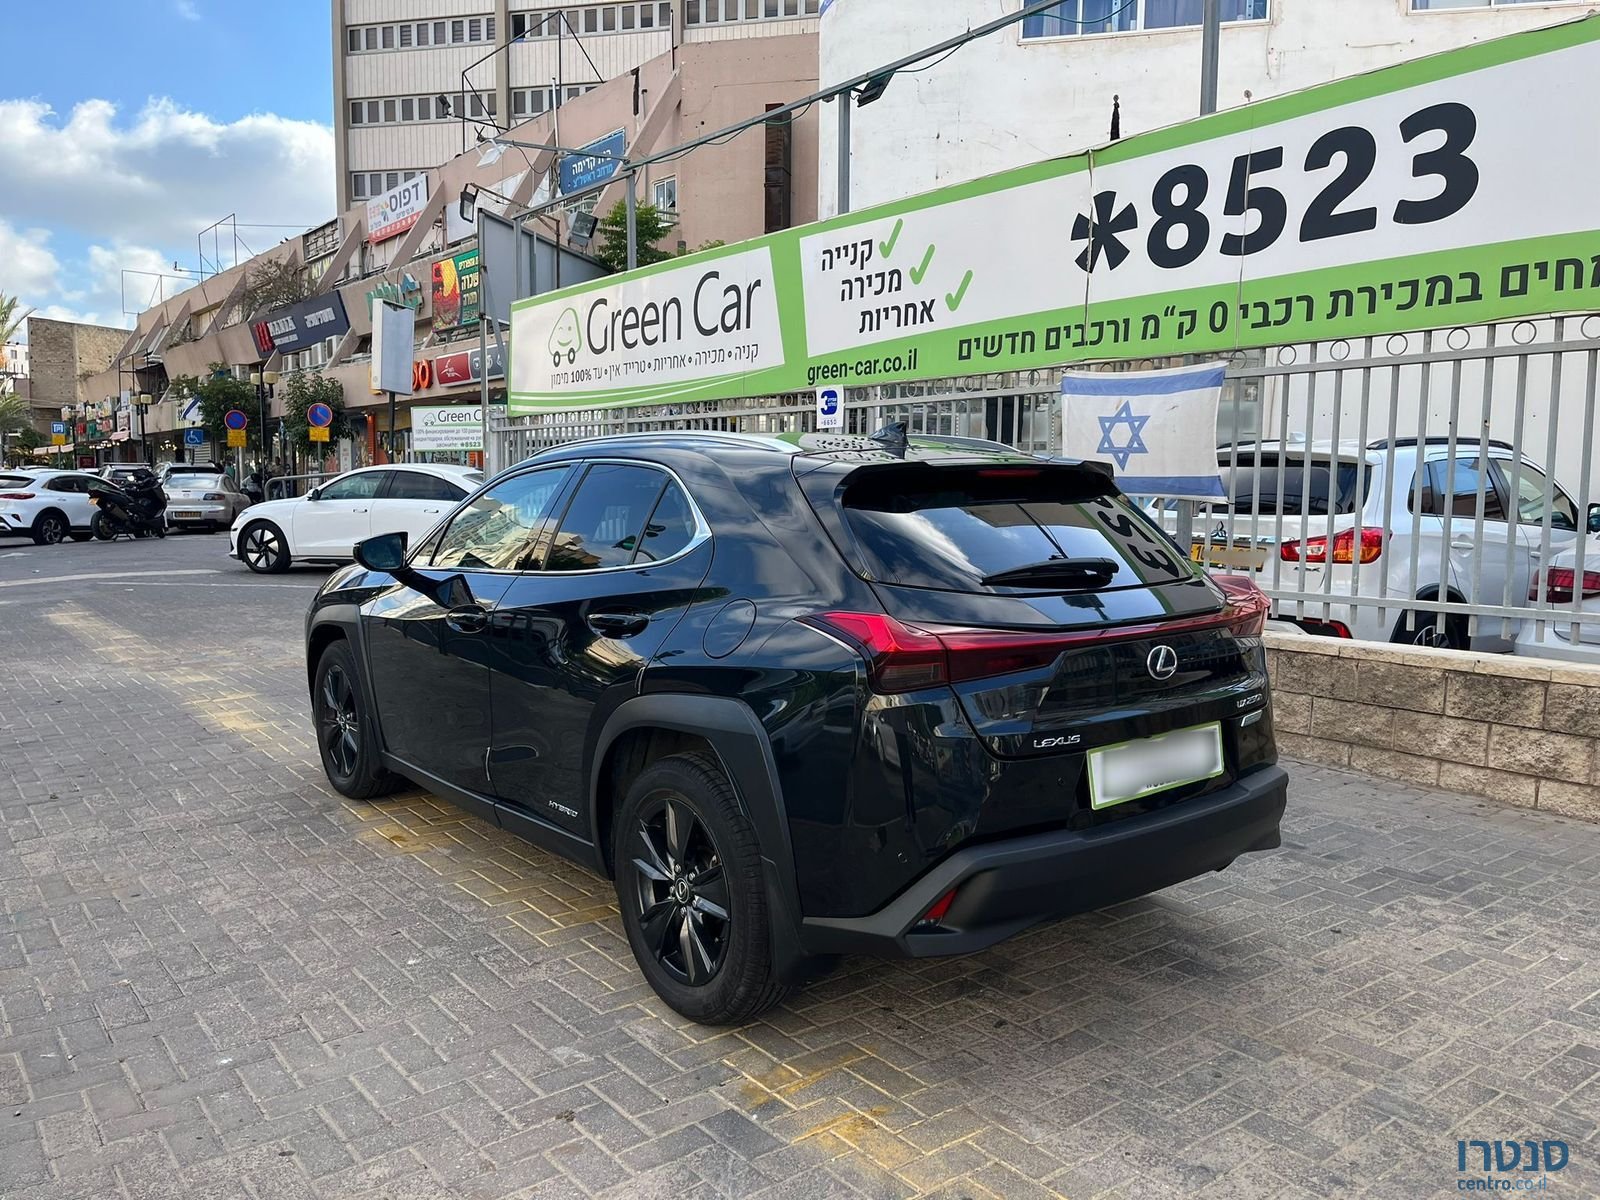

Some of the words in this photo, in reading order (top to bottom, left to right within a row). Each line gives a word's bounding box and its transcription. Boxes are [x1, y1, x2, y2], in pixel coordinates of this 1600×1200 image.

[572, 157, 596, 176] קדימה
[389, 183, 419, 213] דפוס
[821, 239, 873, 271] קנייה
[841, 268, 902, 302] מכירה
[1326, 271, 1483, 320] במכירת
[586, 297, 682, 355] Green
[693, 270, 761, 337] Car
[858, 299, 936, 334] אחריות
[1209, 301, 1229, 333] 0
[1240, 294, 1314, 330] רכבי
[1044, 317, 1130, 352] ורכבים
[734, 343, 759, 363] קניה
[958, 330, 1036, 361] חדשים
[653, 353, 687, 372] אחריות
[694, 348, 725, 366] מכירה
[807, 348, 918, 386] green-car.co.il
[571, 369, 592, 382] 100%
[593, 367, 603, 380] עד
[608, 363, 621, 381] אין
[623, 359, 646, 376] טרייד
[550, 371, 569, 389] מימון
[438, 409, 471, 423] Green
[1033, 735, 1080, 748] LEXUS
[548, 800, 578, 818] HYBRID
